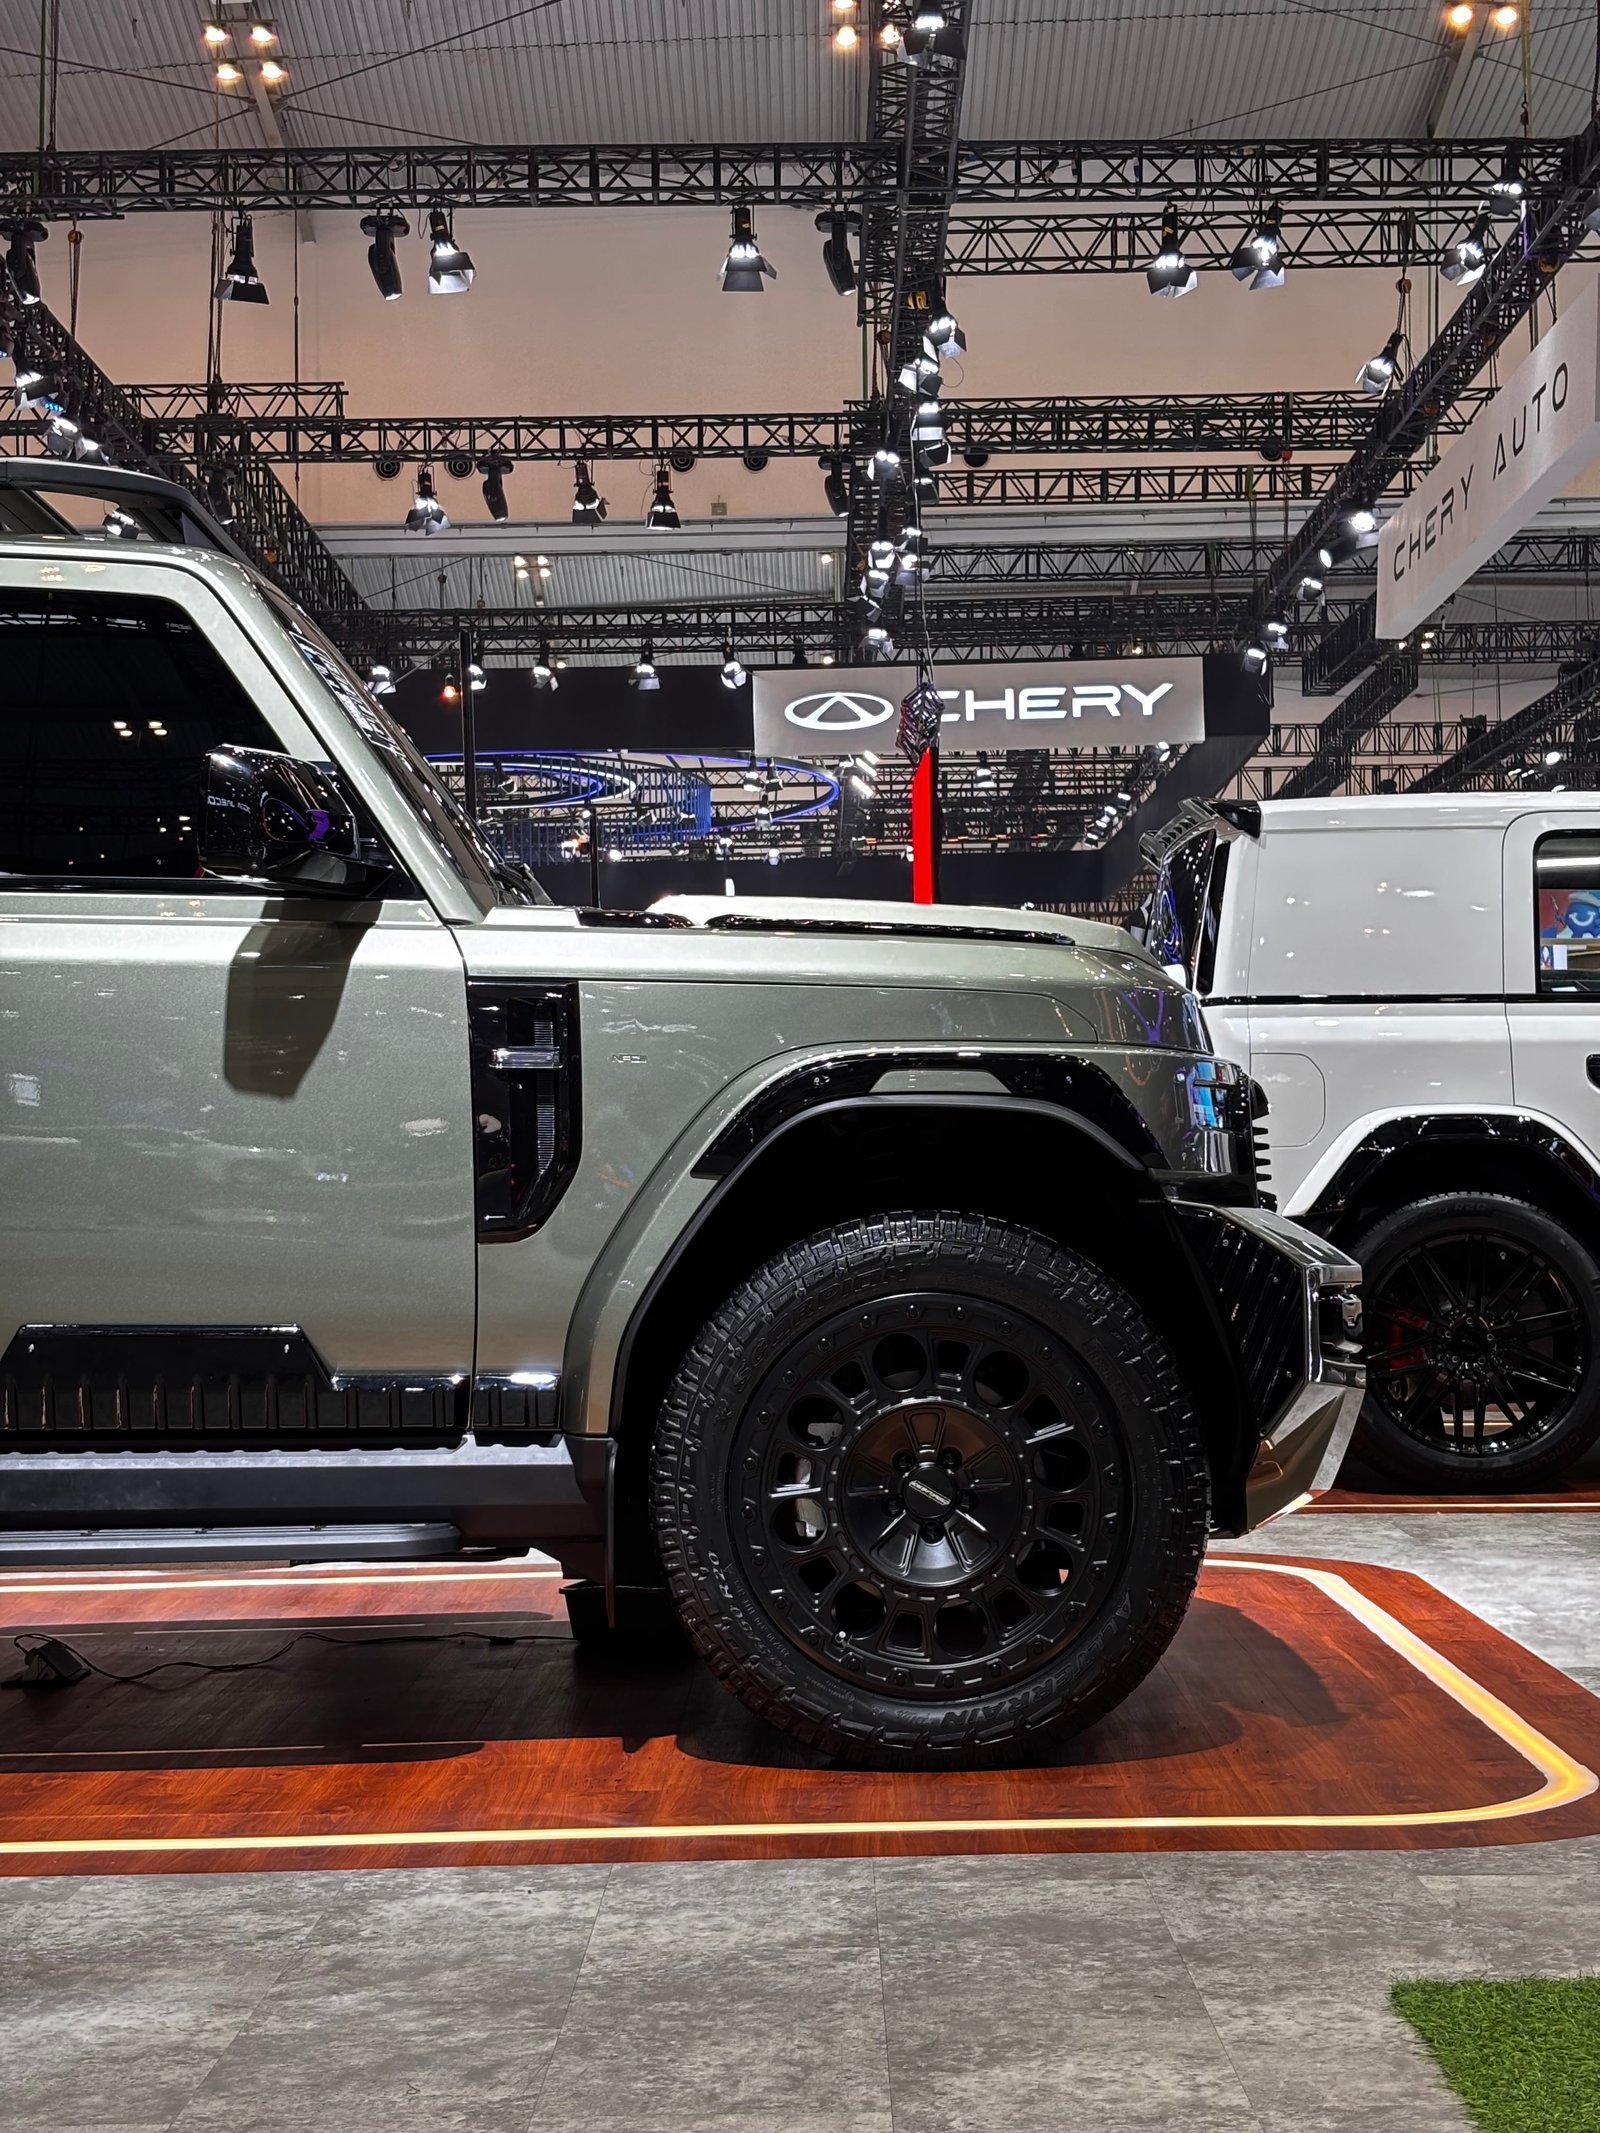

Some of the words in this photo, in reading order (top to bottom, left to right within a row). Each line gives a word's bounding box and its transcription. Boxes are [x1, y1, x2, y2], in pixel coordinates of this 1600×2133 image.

[1393, 464, 1474, 581] CHERY
[1492, 362, 1568, 480] AUTO
[706, 1549, 735, 1602] R20
